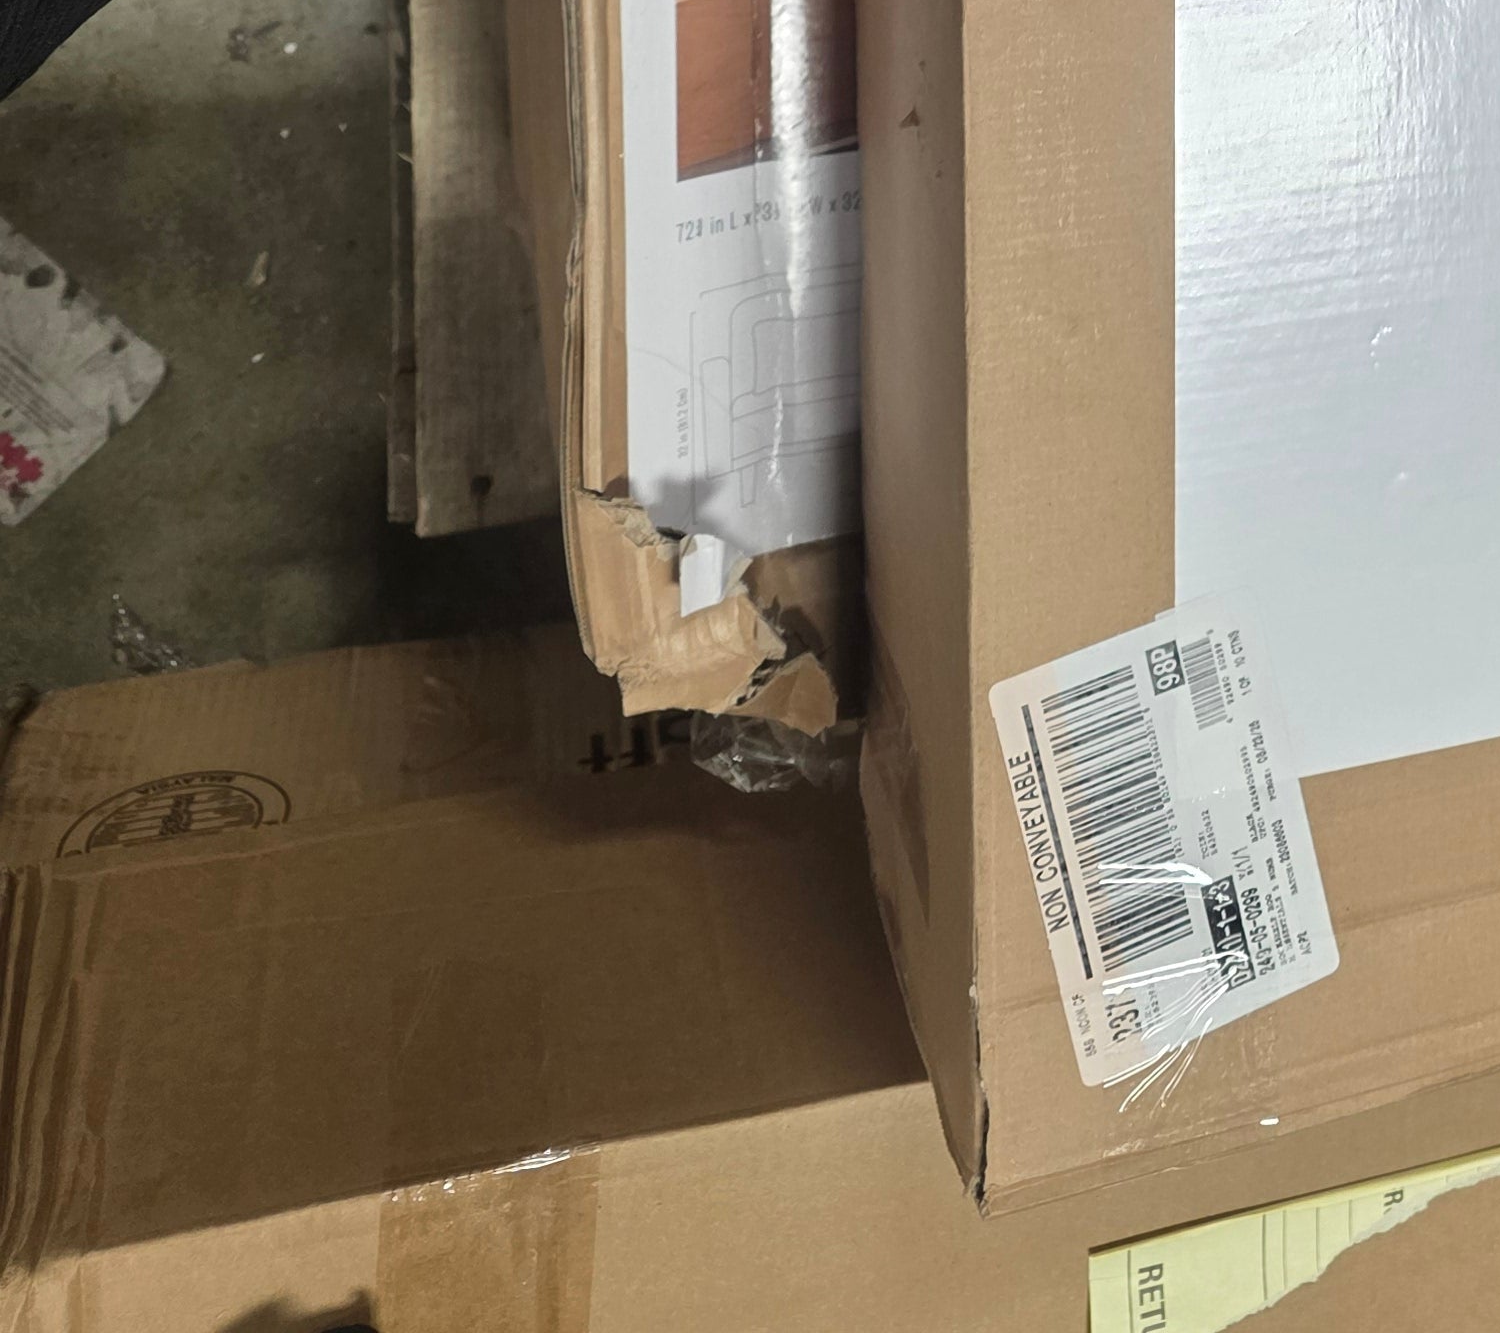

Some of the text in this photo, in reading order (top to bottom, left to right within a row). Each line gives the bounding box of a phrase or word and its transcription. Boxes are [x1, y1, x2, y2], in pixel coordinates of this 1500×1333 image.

[1146, 642, 1183, 692] 98P
[1008, 752, 1070, 933] NON CONVEYABLE
